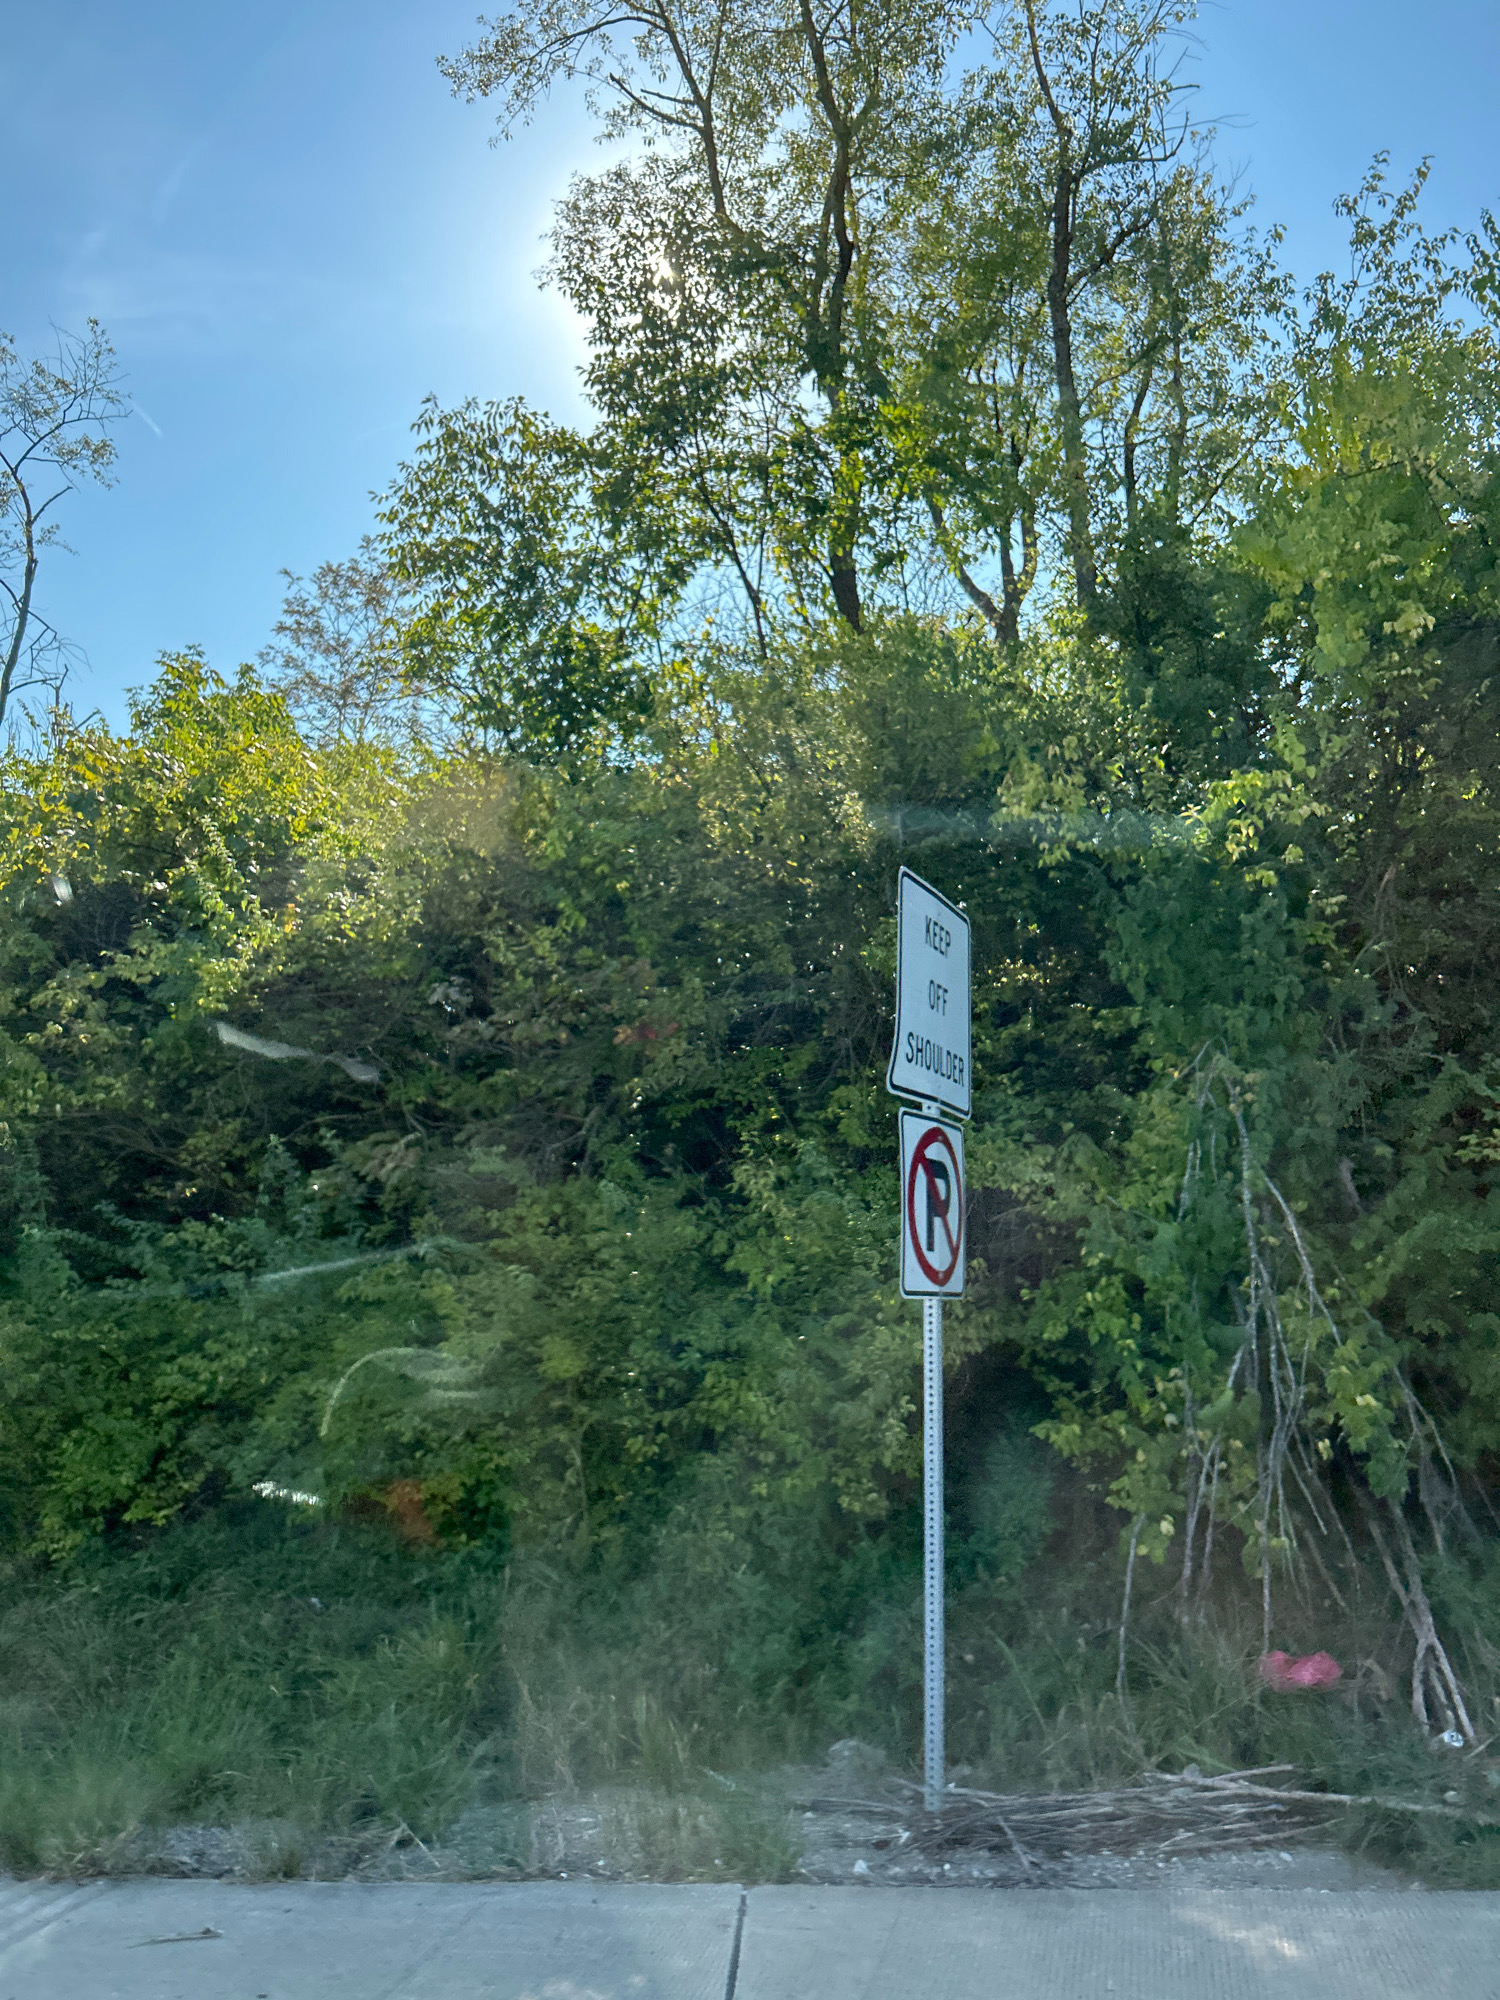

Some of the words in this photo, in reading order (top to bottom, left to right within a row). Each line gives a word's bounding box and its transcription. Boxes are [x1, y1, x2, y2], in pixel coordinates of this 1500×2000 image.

[925, 914, 951, 959] KEEP
[928, 979, 948, 1016] OFF
[906, 1031, 964, 1087] SHOULDER
[926, 1158, 951, 1252] P
